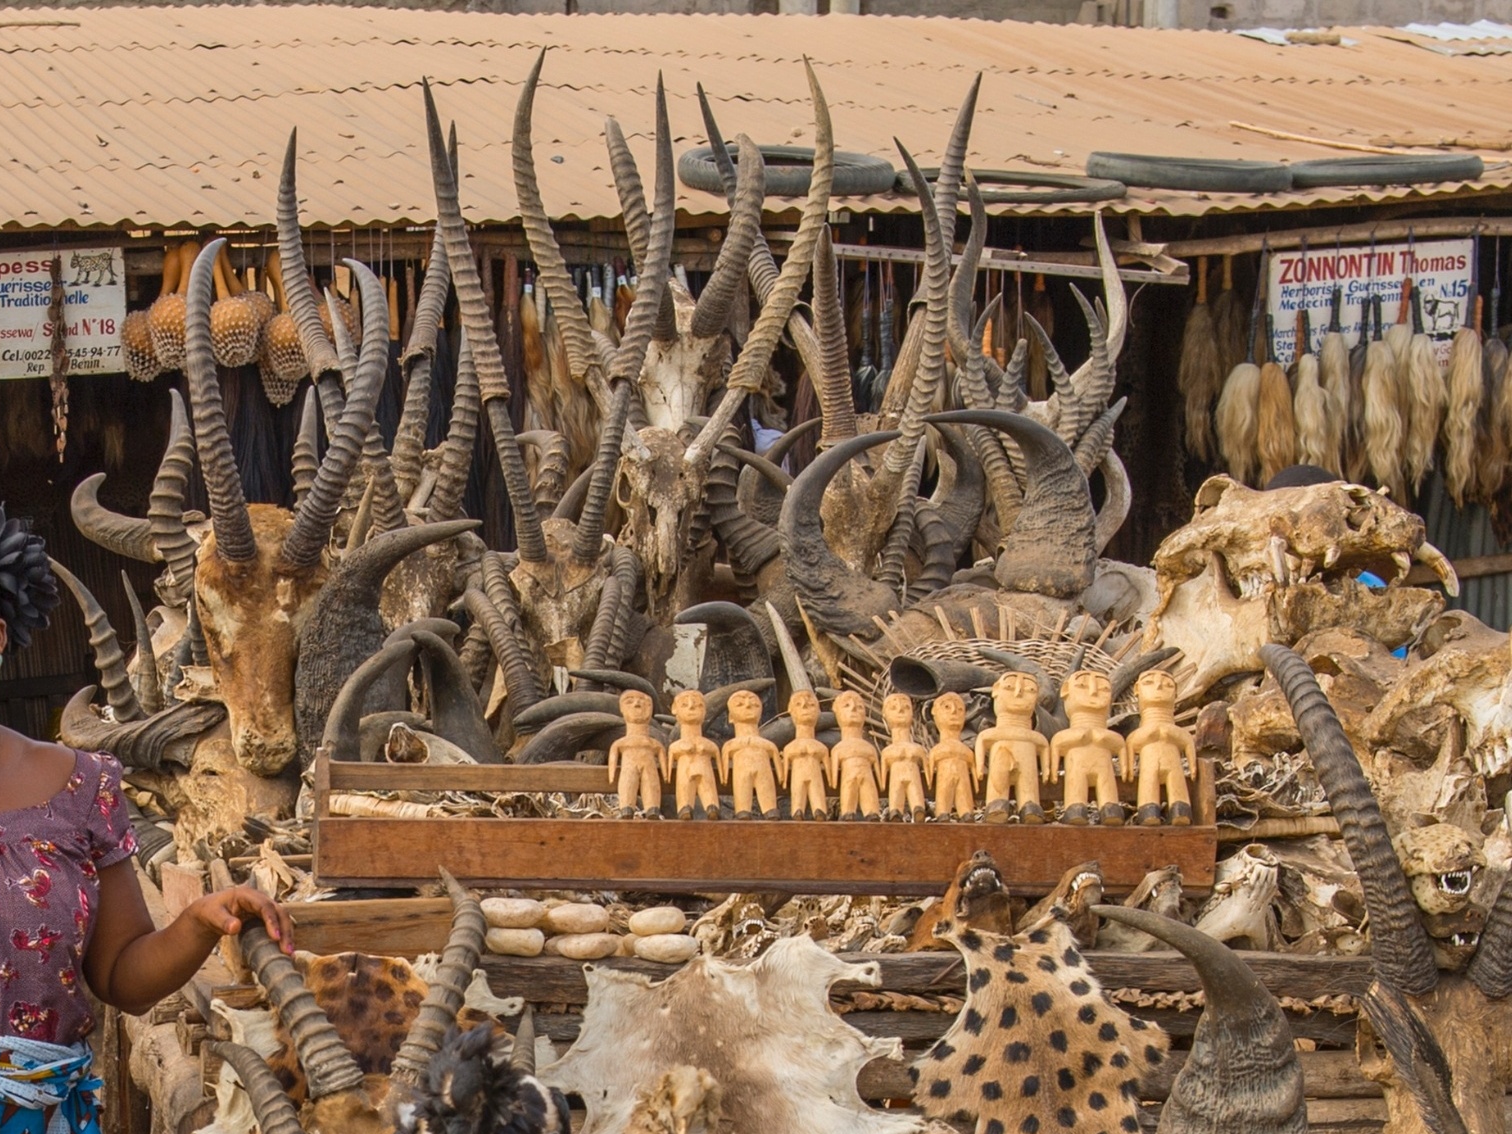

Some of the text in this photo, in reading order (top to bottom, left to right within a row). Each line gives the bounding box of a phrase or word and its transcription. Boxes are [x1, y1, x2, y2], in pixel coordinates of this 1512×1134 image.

[1279, 250, 1467, 284] ZONNONTIN Thomas
[1419, 277, 1435, 287] en
[42, 322, 78, 337] Snd
